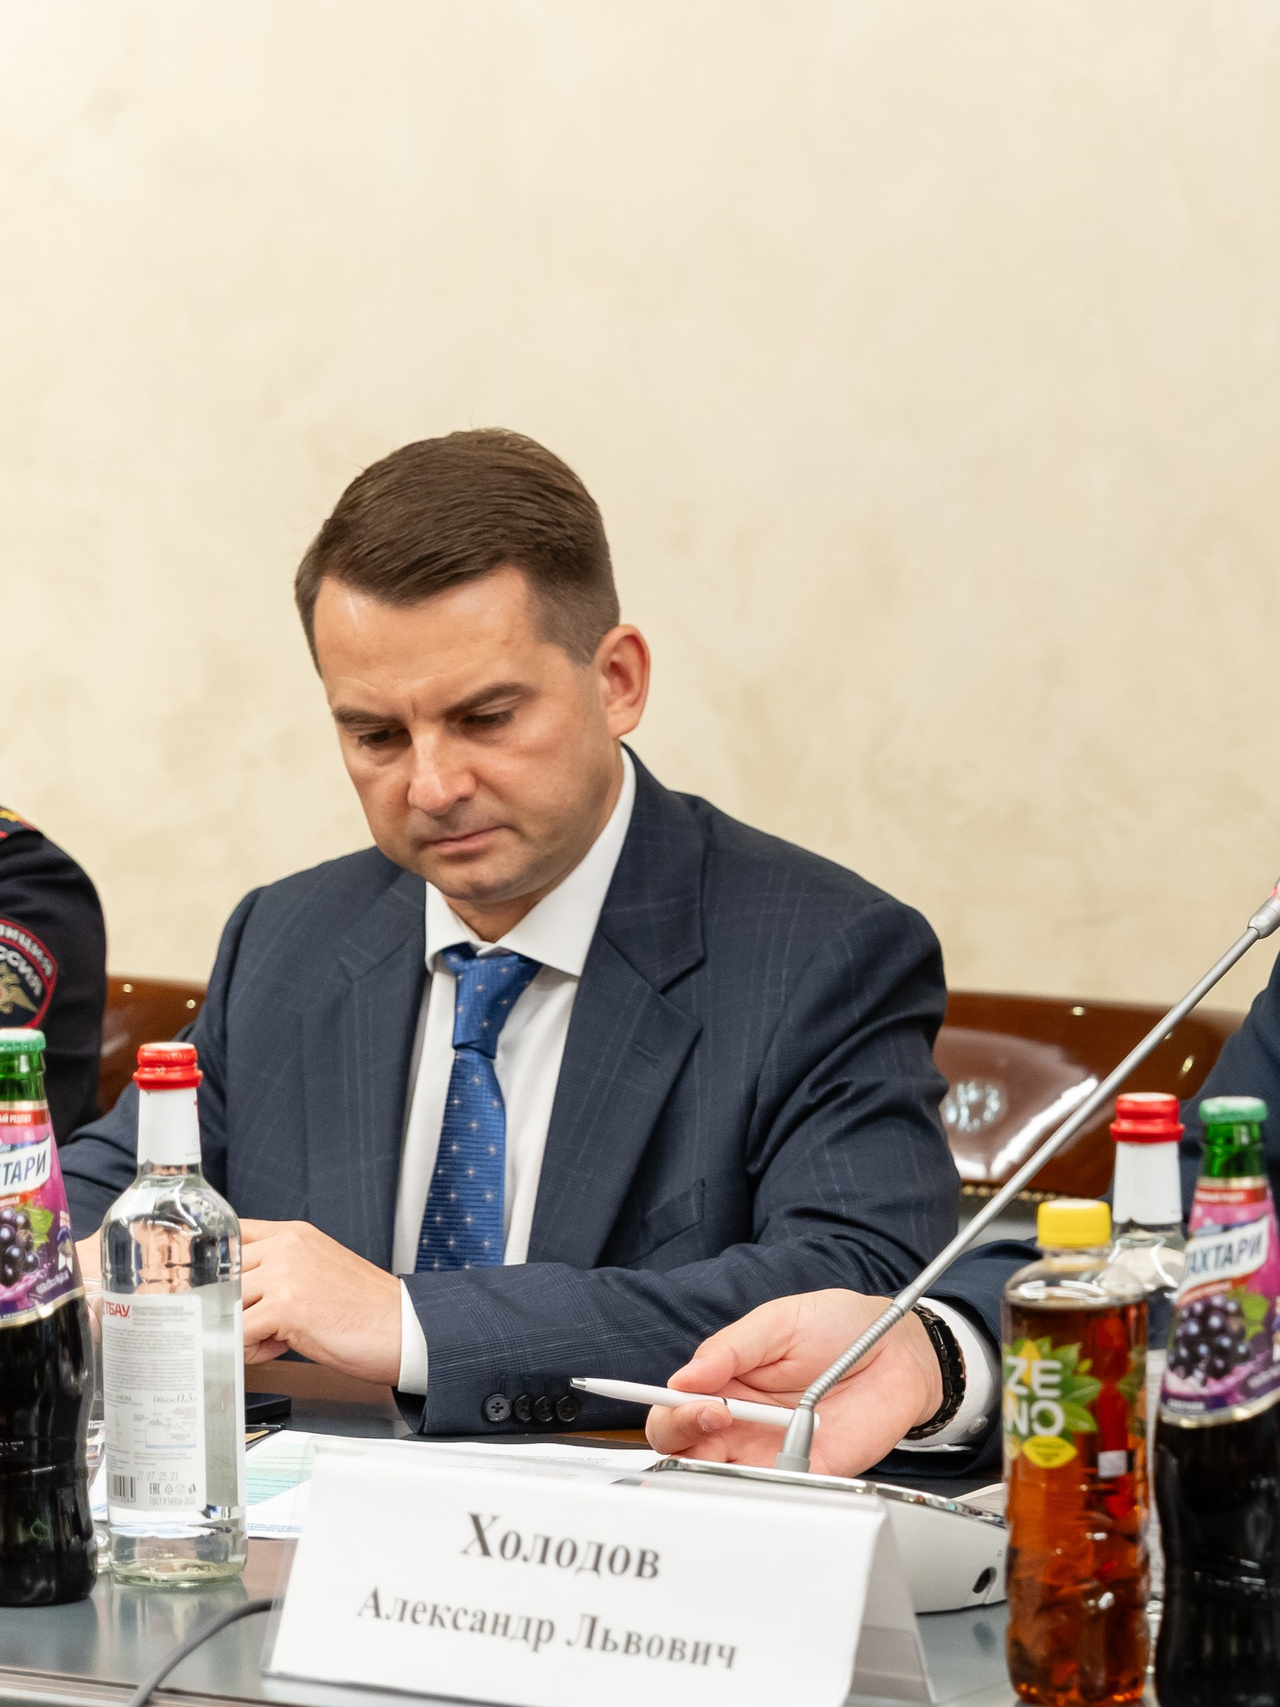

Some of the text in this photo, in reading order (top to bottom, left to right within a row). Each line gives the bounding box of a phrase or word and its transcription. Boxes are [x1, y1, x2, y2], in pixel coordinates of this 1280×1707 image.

[0, 1149, 47, 1187] ТАРИ
[105, 1300, 131, 1318] ТБАУ
[460, 1511, 661, 1580] Холодов
[356, 1585, 739, 1670] Александр Львович
